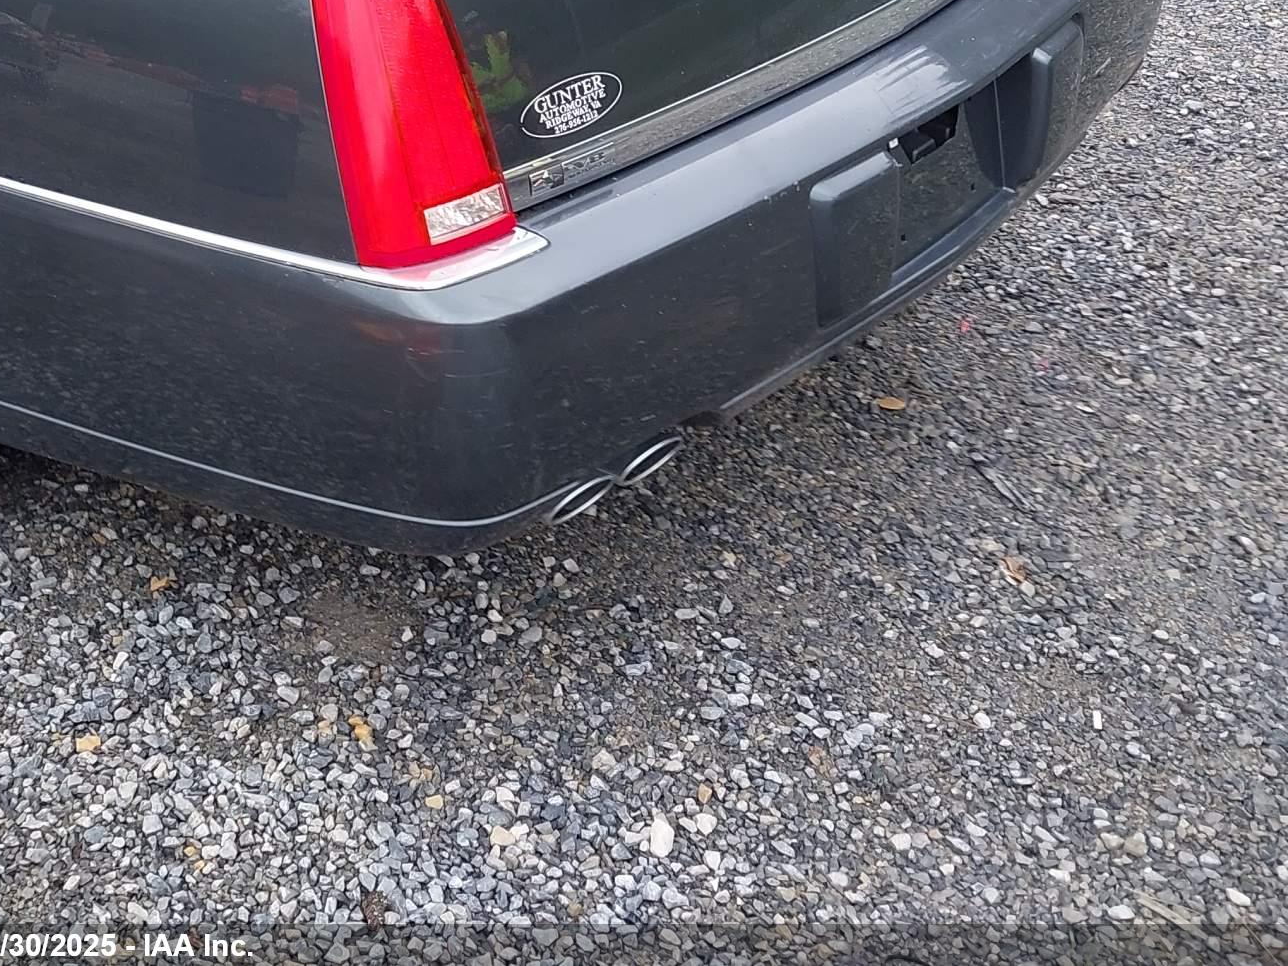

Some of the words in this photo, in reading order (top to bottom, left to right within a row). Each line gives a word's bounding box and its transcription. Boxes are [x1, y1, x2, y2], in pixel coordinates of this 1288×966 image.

[534, 75, 606, 114] GUNTER
[539, 88, 606, 124] AUTOMOTIVE
[589, 100, 602, 110] VA
